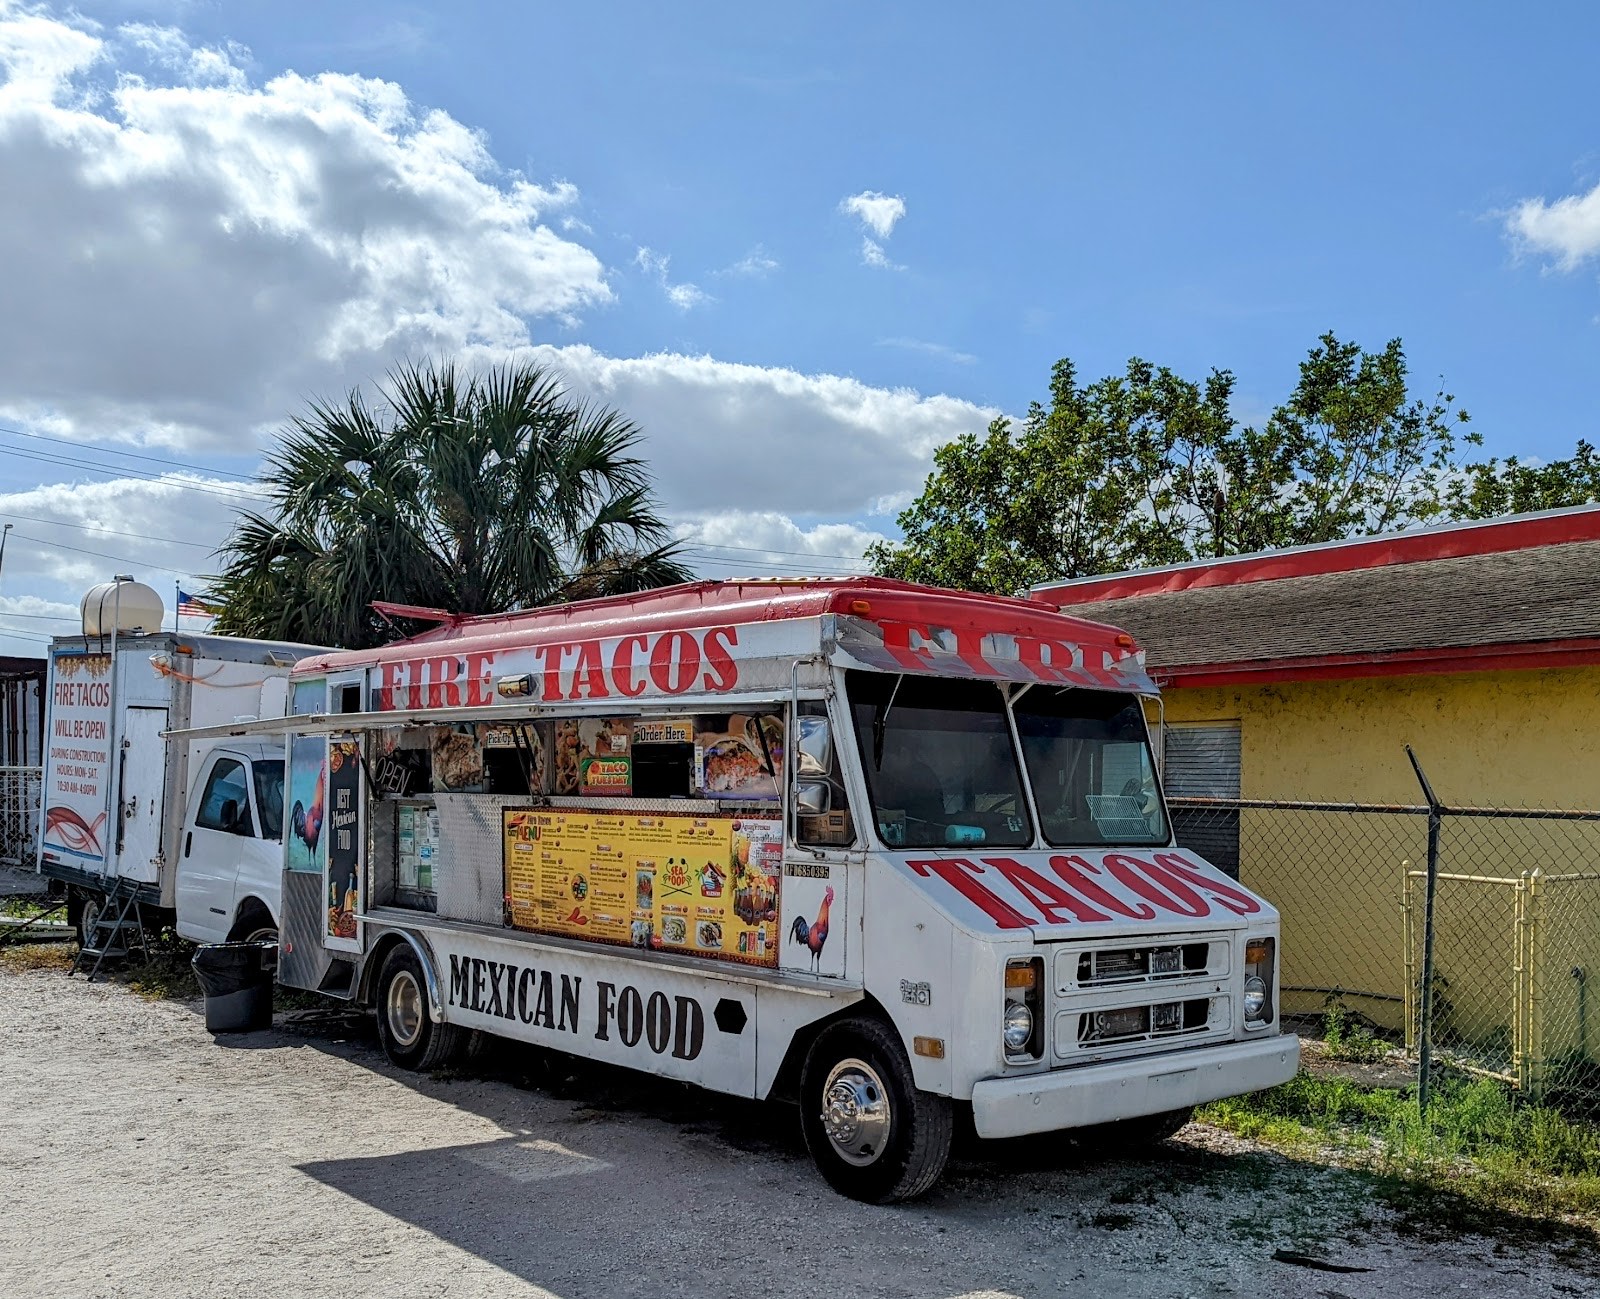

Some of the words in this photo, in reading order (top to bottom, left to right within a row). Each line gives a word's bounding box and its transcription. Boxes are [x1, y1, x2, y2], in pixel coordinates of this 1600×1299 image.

[380, 652, 494, 711] FIRE
[535, 626, 739, 701] TACOS
[54, 682, 75, 706] FIRE
[77, 682, 110, 707] TACOS
[55, 719, 72, 737] WILL
[74, 720, 83, 738] BE
[85, 720, 106, 739] OPEN
[640, 726, 663, 741] Order
[665, 726, 685, 740] Here
[51, 747, 69, 760] DURING
[376, 756, 412, 795] OPEN
[600, 762, 628, 774] TACO
[591, 775, 629, 785] TUESDAY
[336, 788, 351, 809] BEST
[332, 808, 357, 830] Mexican
[337, 829, 351, 850] FOOD
[516, 826, 542, 842] MENU
[668, 874, 686, 886] FOOD
[670, 865, 684, 876] SEA
[905, 853, 1261, 929] TACOS
[449, 954, 581, 1034] MEXICAN
[594, 980, 704, 1061] FOOD
